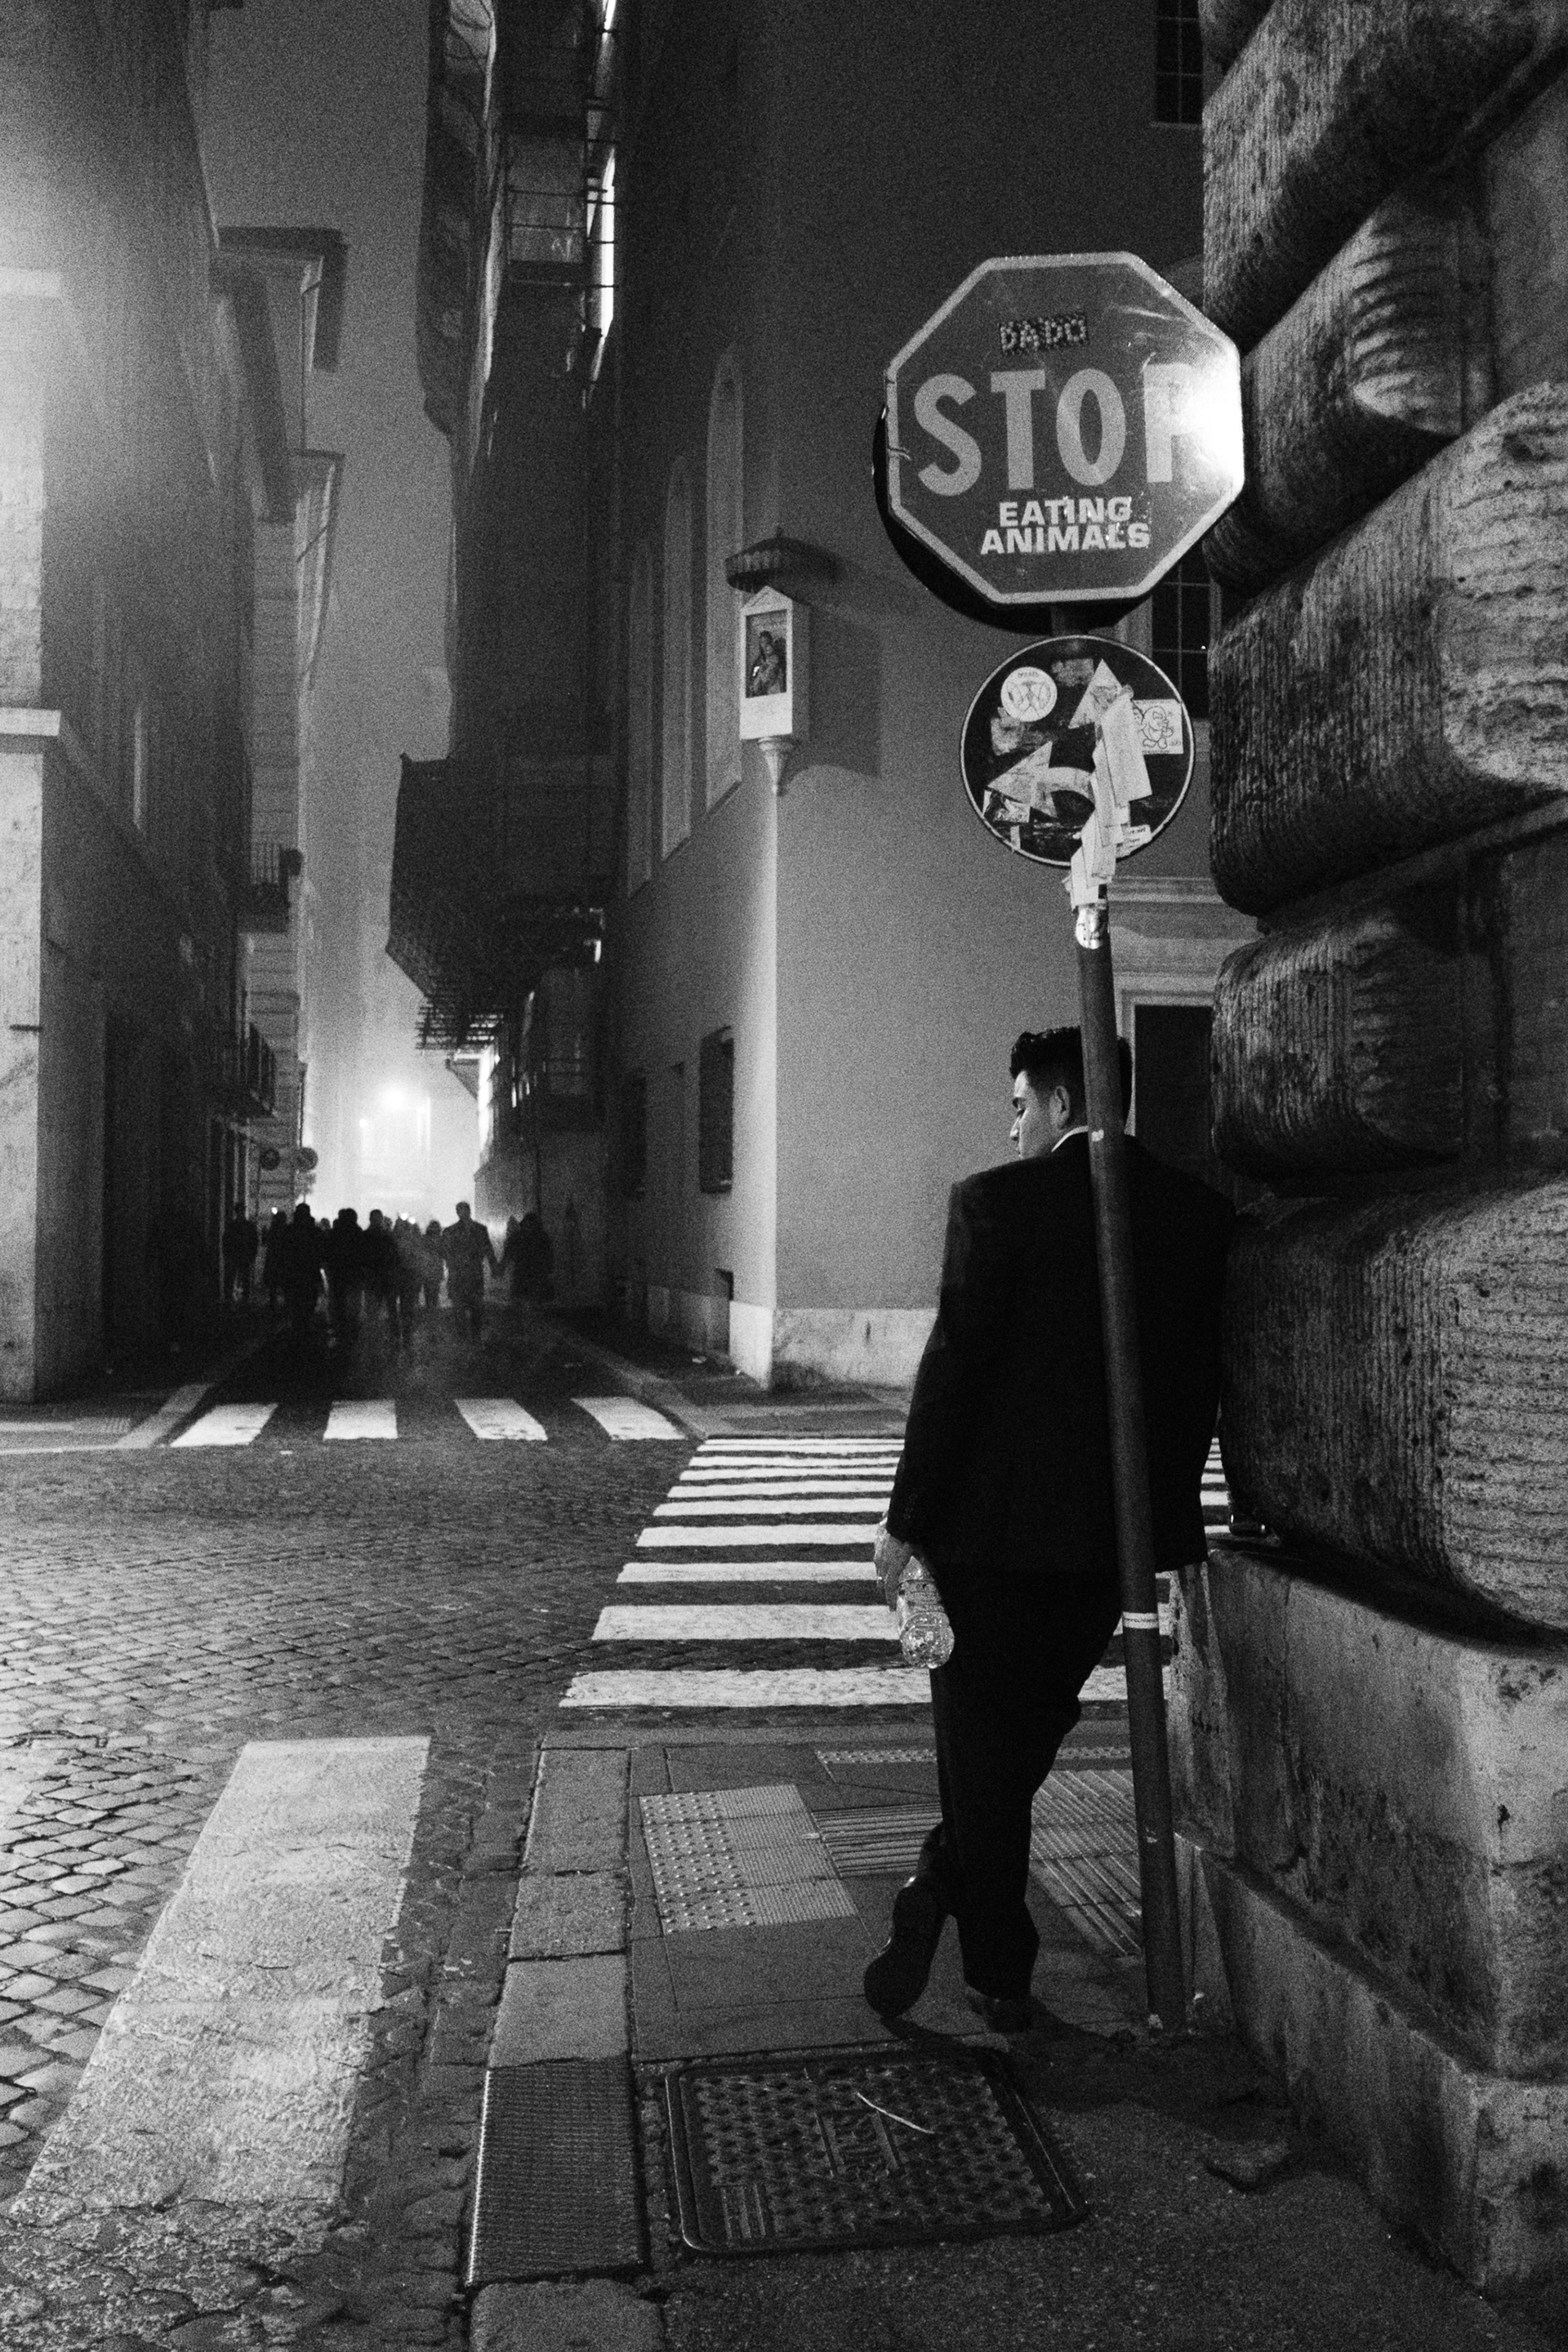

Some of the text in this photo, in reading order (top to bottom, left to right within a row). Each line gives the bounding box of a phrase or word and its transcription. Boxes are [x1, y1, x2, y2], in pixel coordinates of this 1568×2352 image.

[914, 364, 1202, 497] STOP
[1000, 497, 1132, 527] EATING
[980, 523, 1151, 555] ANIMALS
